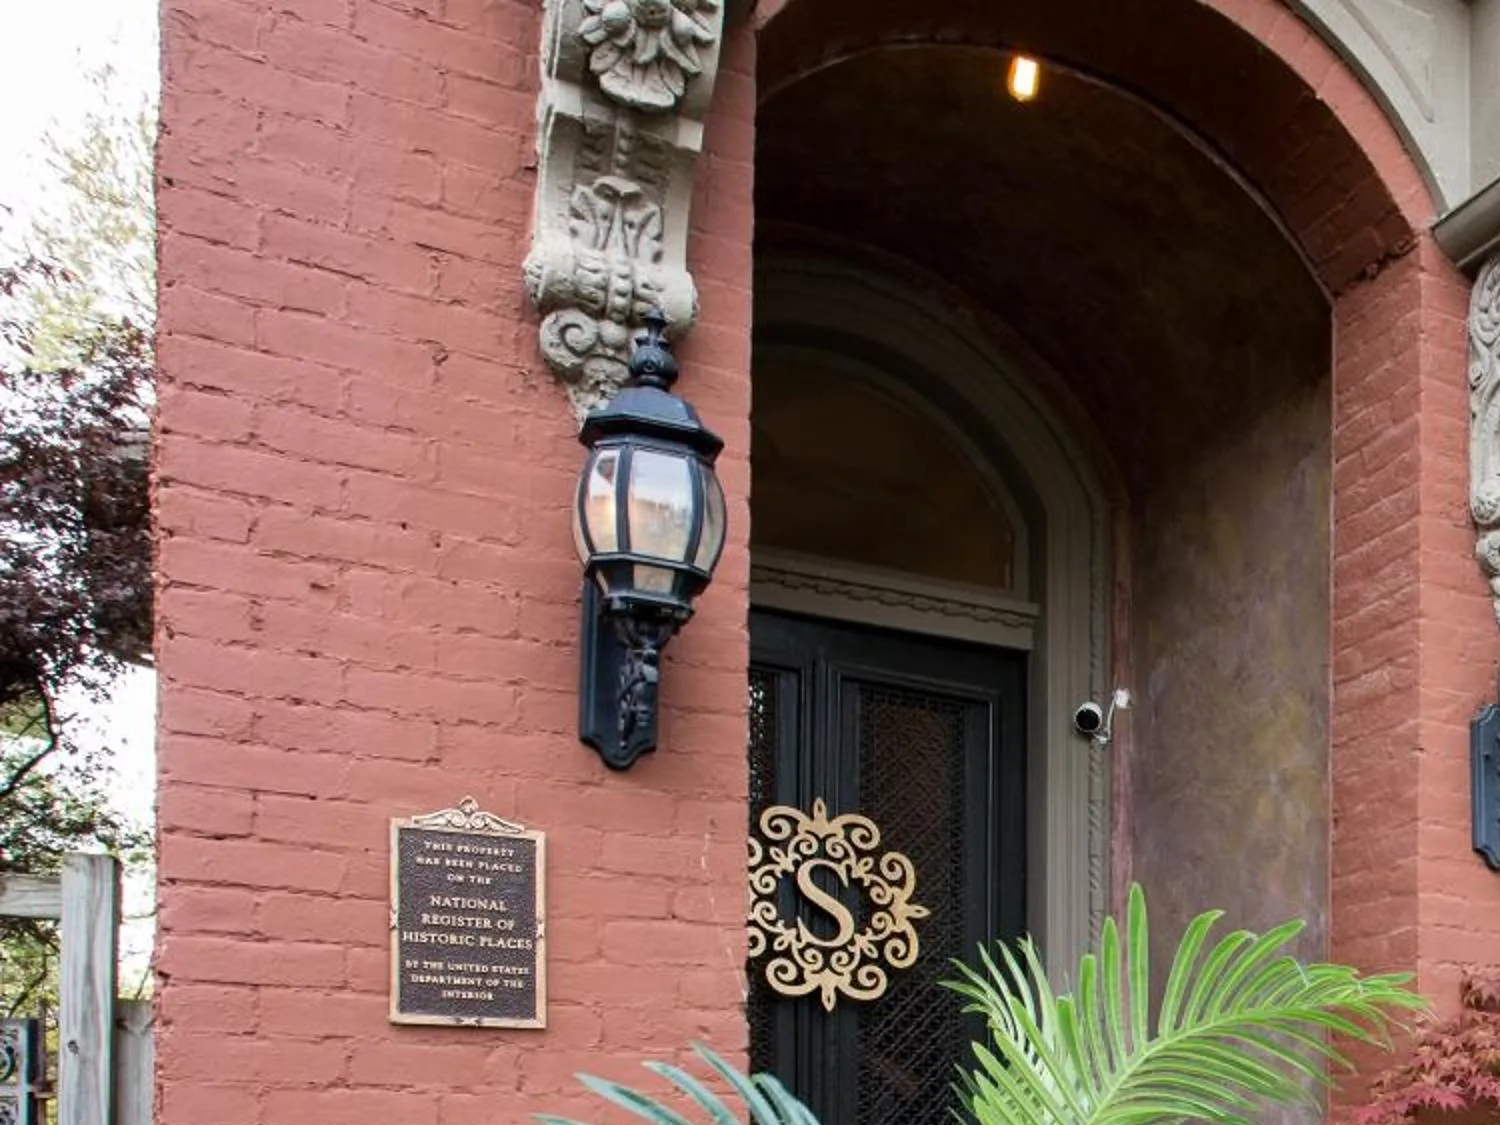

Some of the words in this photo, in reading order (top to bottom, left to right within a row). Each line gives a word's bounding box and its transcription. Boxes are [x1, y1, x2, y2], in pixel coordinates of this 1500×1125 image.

[457, 845, 515, 857] PROPERTY
[445, 858, 473, 868] BEEN
[478, 861, 522, 873] PLACED
[447, 873, 465, 883] ON
[469, 875, 491, 885] THE
[430, 894, 507, 911] NATIONAL
[797, 858, 855, 947] S
[421, 913, 493, 930] REGISTER
[496, 918, 515, 931] OF
[403, 931, 475, 946] HISTORIC
[479, 936, 533, 950] PLACES
[422, 961, 444, 970] THE
[448, 961, 489, 973] UNITED
[492, 966, 530, 975] STATES
[411, 974, 482, 986] DEPARTMENT
[485, 978, 499, 987] OF
[504, 979, 524, 989] THE
[441, 989, 494, 1000] INTERIOR
